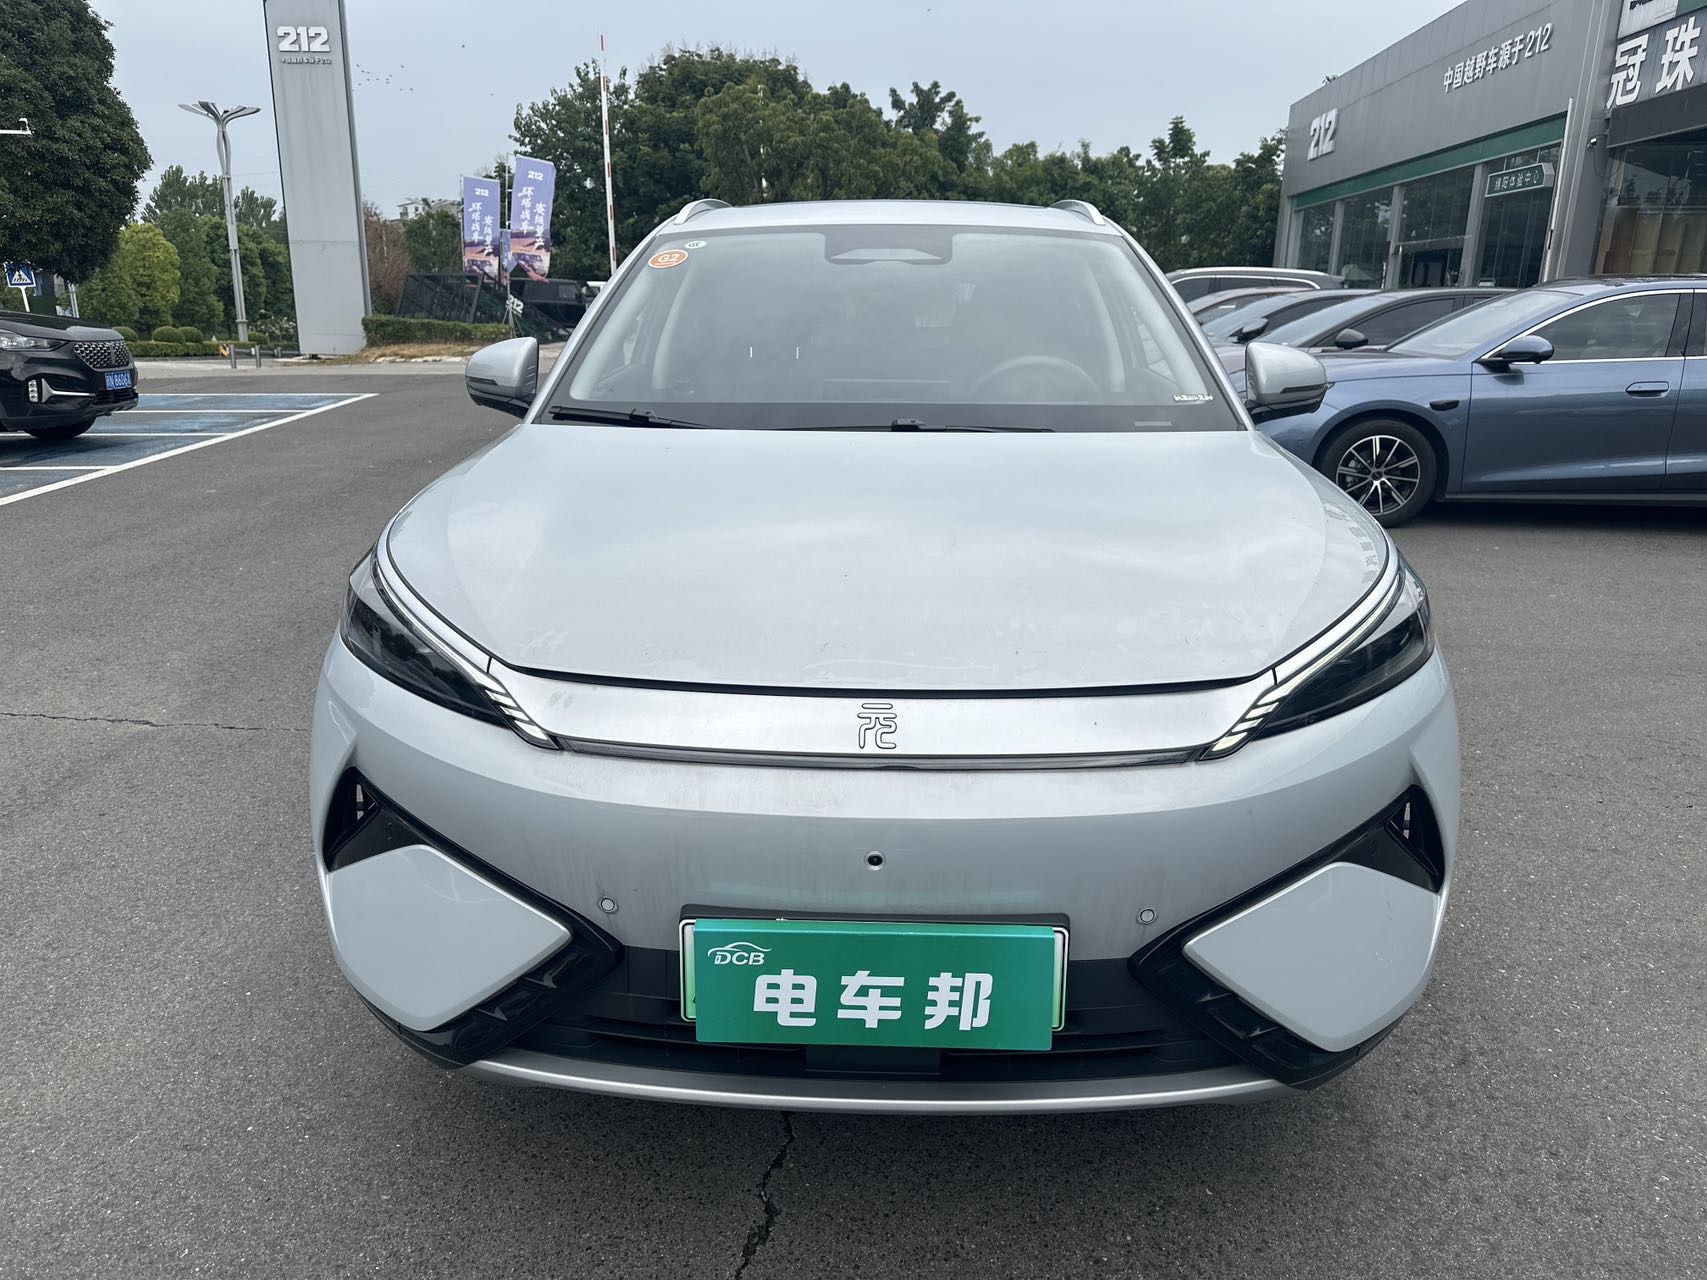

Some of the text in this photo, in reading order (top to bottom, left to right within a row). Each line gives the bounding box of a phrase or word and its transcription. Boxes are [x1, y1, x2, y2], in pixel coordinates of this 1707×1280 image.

[277, 26, 330, 52] 212
[1443, 22, 1552, 93] 中国越野车源于212
[1606, 16, 1702, 110] 冠珠
[1307, 108, 1338, 161] 212
[527, 170, 543, 181] 212
[474, 187, 490, 197] 212
[657, 253, 681, 263] G2
[713, 951, 766, 965] DCB
[753, 968, 994, 1031] 电车邦
